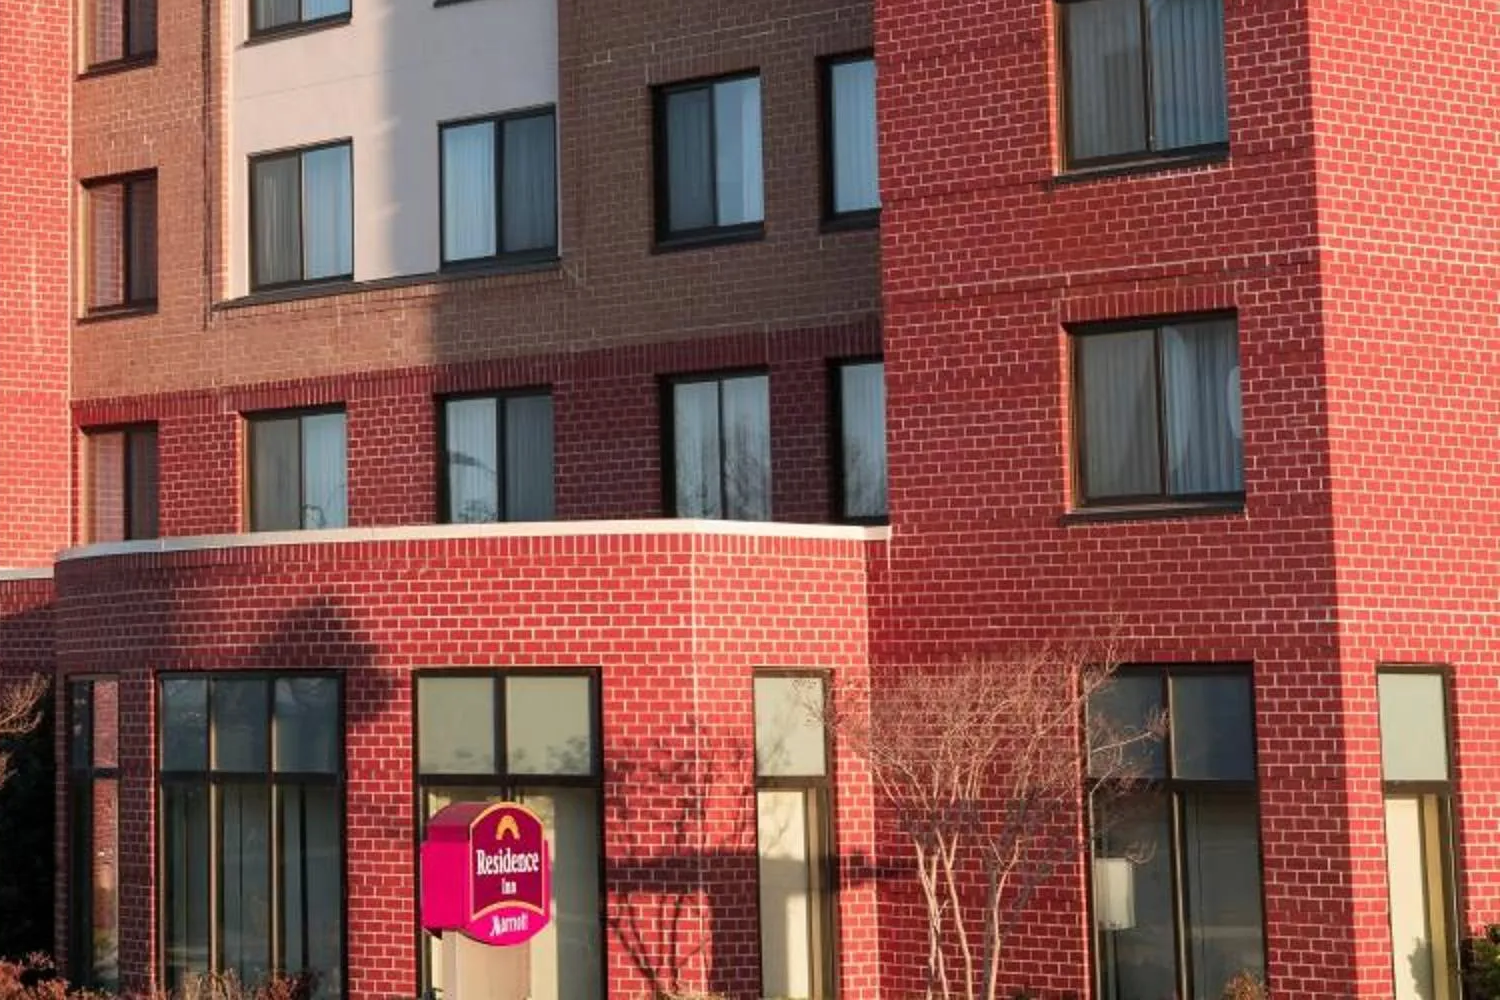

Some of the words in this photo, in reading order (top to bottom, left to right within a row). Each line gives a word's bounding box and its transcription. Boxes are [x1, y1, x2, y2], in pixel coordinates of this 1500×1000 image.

[476, 847, 539, 875] Residence
[501, 877, 517, 895] Inn
[489, 912, 529, 937] Marriott
